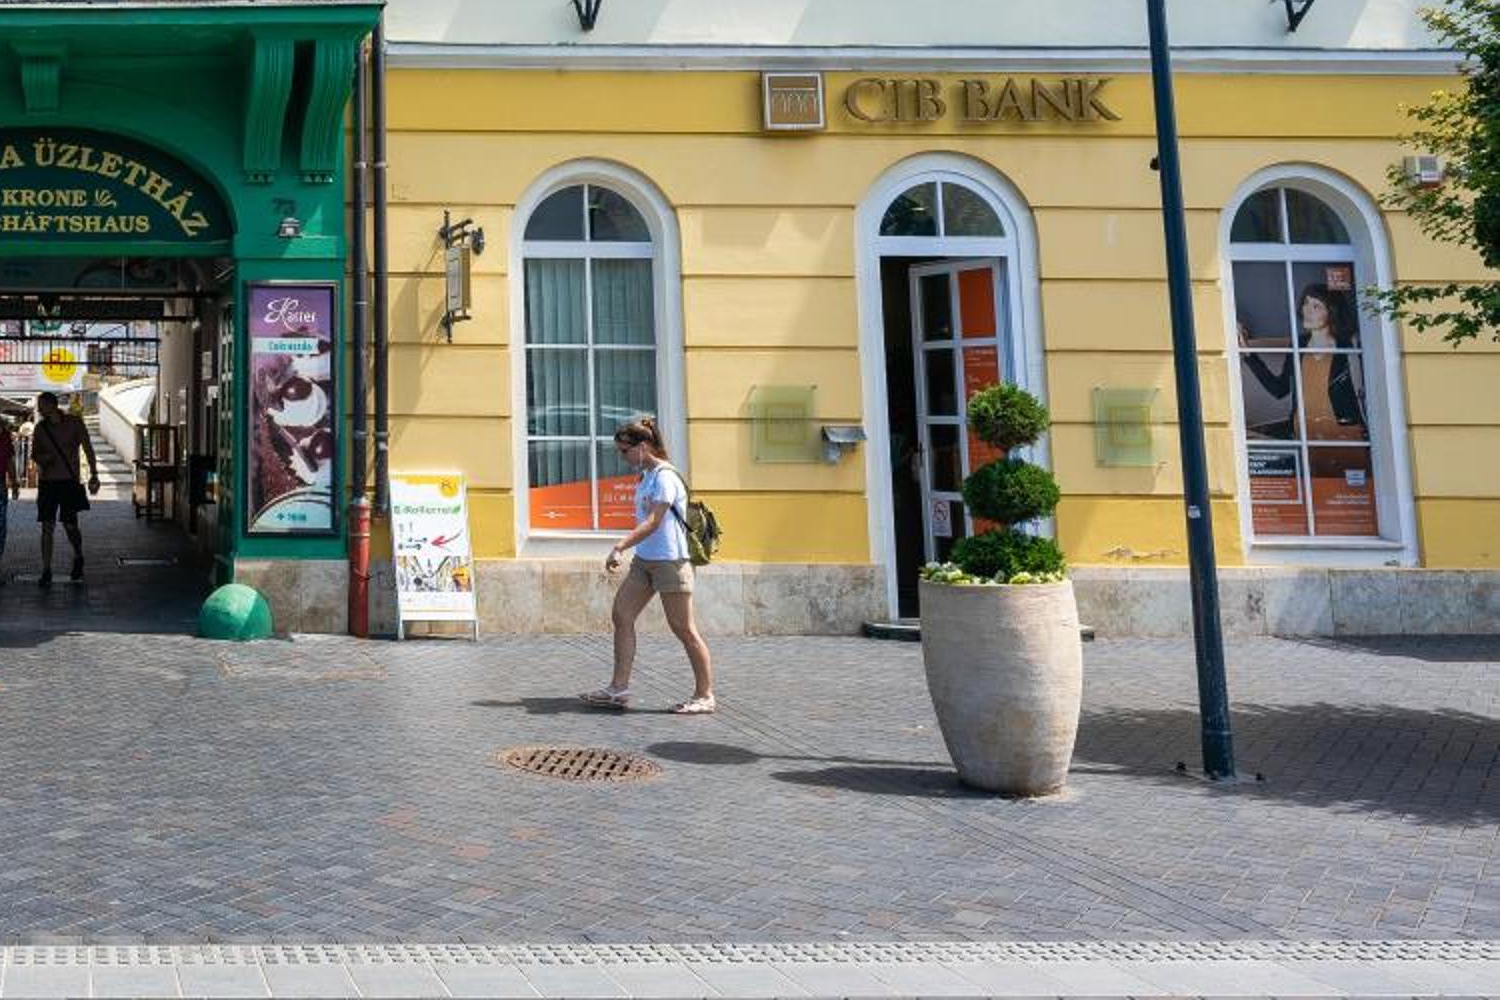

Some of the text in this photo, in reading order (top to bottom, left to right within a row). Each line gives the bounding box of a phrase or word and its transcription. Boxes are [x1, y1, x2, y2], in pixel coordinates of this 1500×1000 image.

[844, 76, 1123, 122] CIB BANK
[2, 188, 88, 208] KRONE
[31, 136, 211, 238] ÜZLETHÁZ
